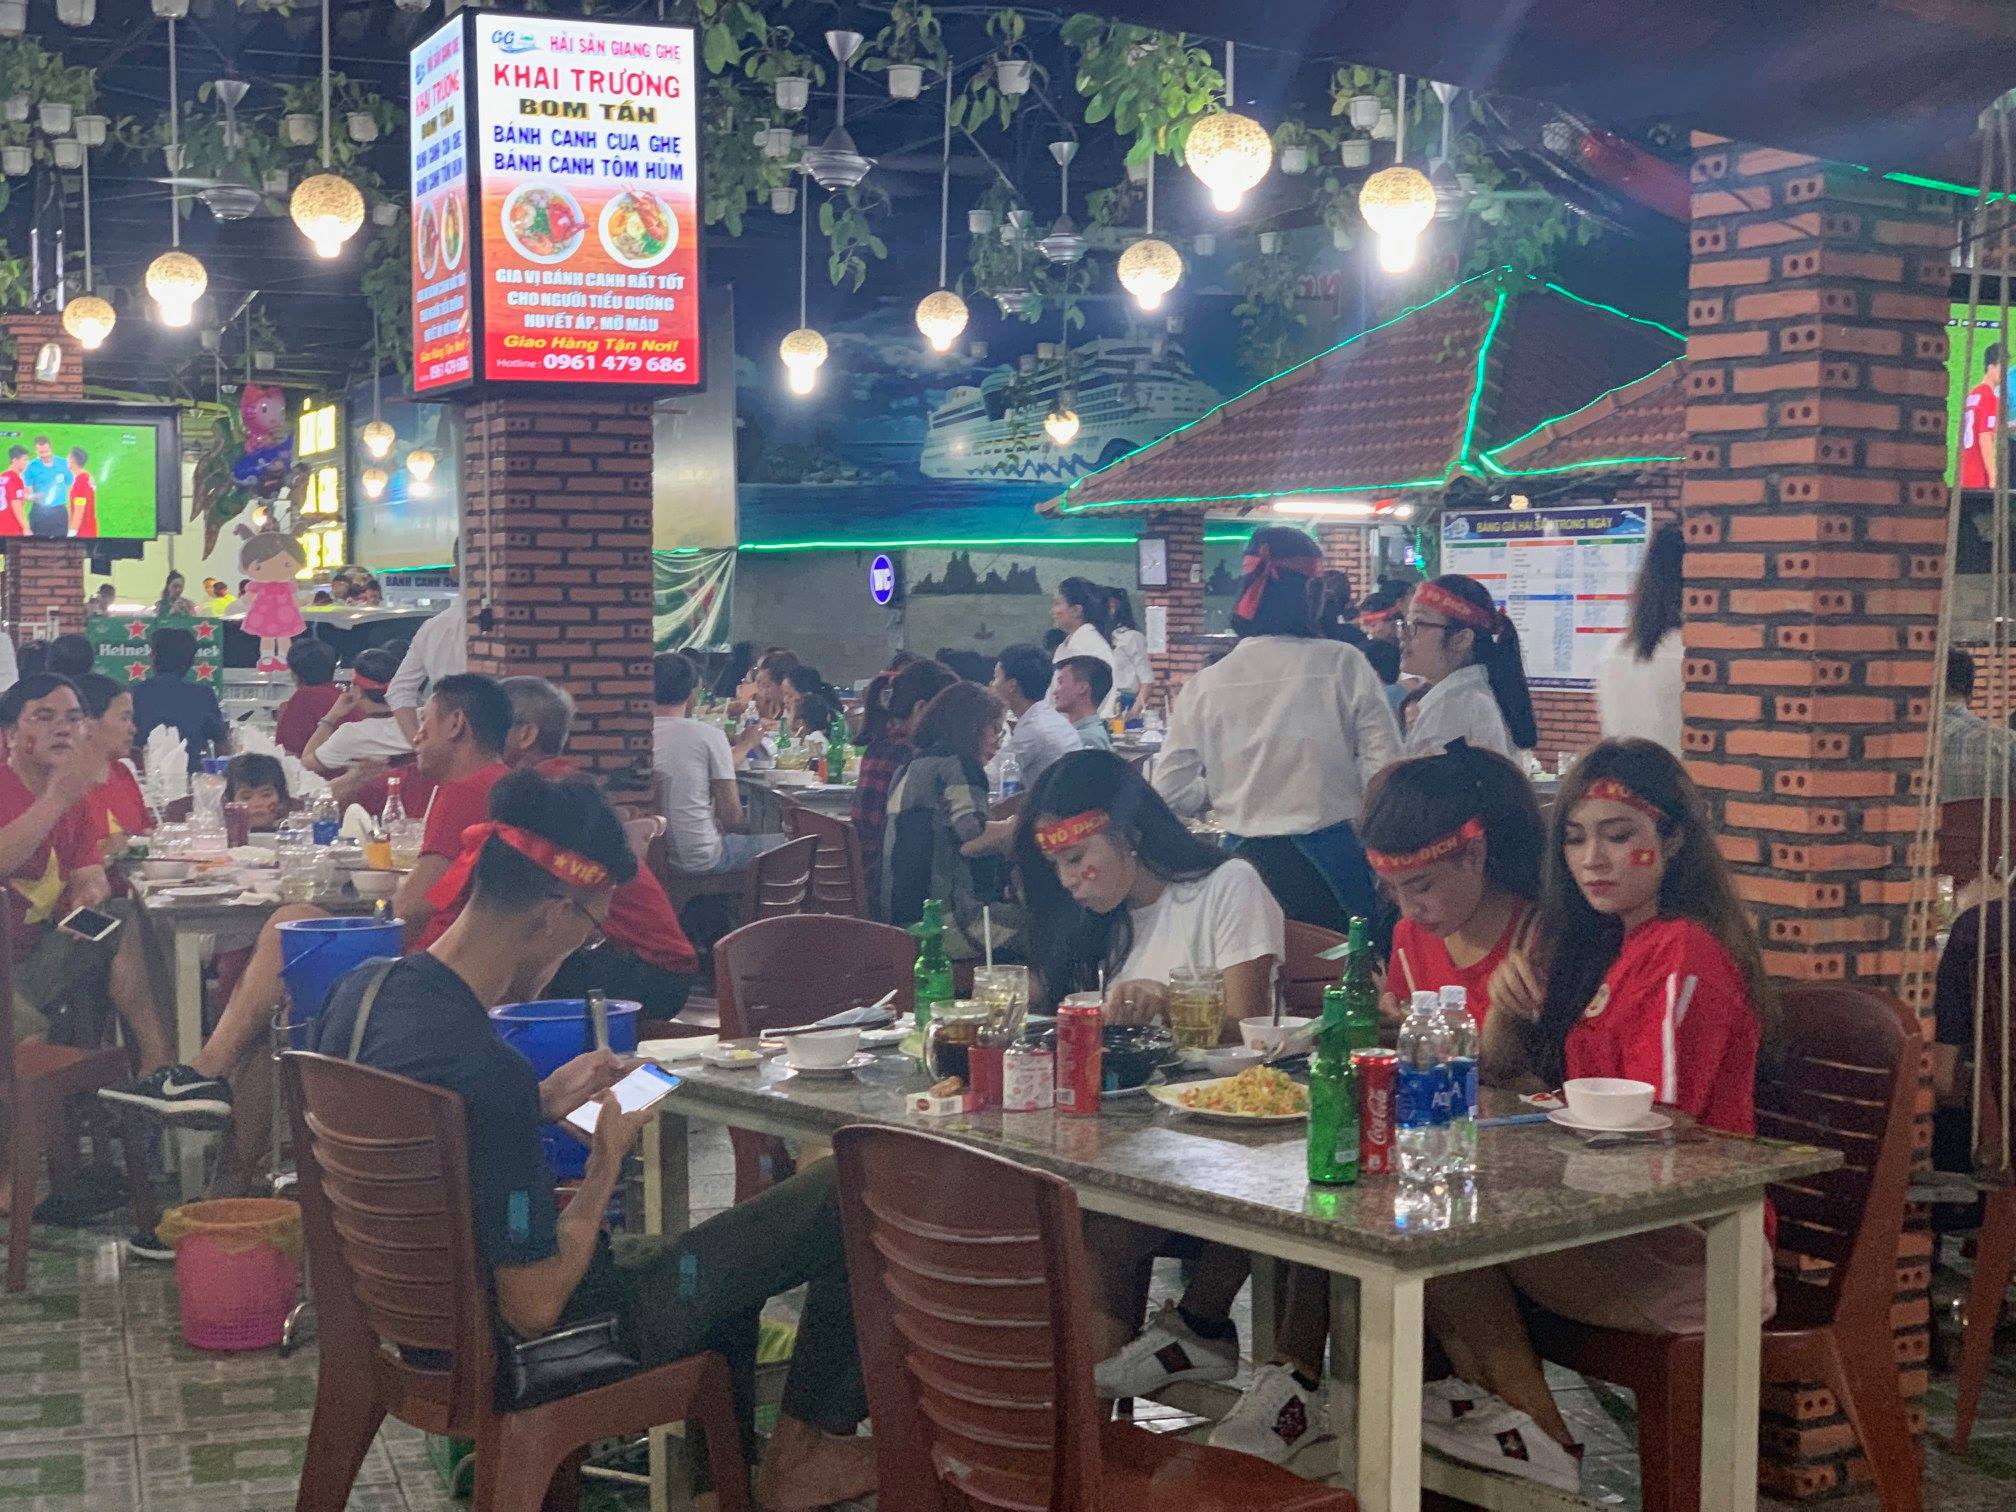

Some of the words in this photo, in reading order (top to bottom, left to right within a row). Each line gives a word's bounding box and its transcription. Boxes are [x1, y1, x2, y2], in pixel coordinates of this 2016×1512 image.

[550, 32, 573, 52] HẢI
[579, 33, 606, 56] SẢN
[611, 39, 650, 58] GIANG
[656, 44, 681, 64] GHẸ
[494, 63, 559, 90] KHAI
[570, 68, 681, 99] TRƯƠNG
[519, 98, 590, 120] BOM
[494, 121, 541, 145] BÁNH
[551, 128, 597, 149] CANH
[606, 132, 640, 151] CUA
[649, 135, 682, 159] GHẸ
[494, 148, 542, 172] BÁNH
[549, 155, 595, 176] CANH
[601, 155, 639, 178] TÔM
[645, 158, 683, 181] HÙM
[495, 268, 523, 284] GIA
[542, 268, 583, 287] BÁNH
[585, 272, 625, 288] CANH
[507, 290, 539, 306] CHO
[503, 335, 547, 349] Giao
[551, 336, 600, 353] Hàng
[604, 337, 637, 352] Tận
[543, 353, 596, 371] 0961
[601, 355, 642, 372] 479
[646, 356, 687, 373] 686
